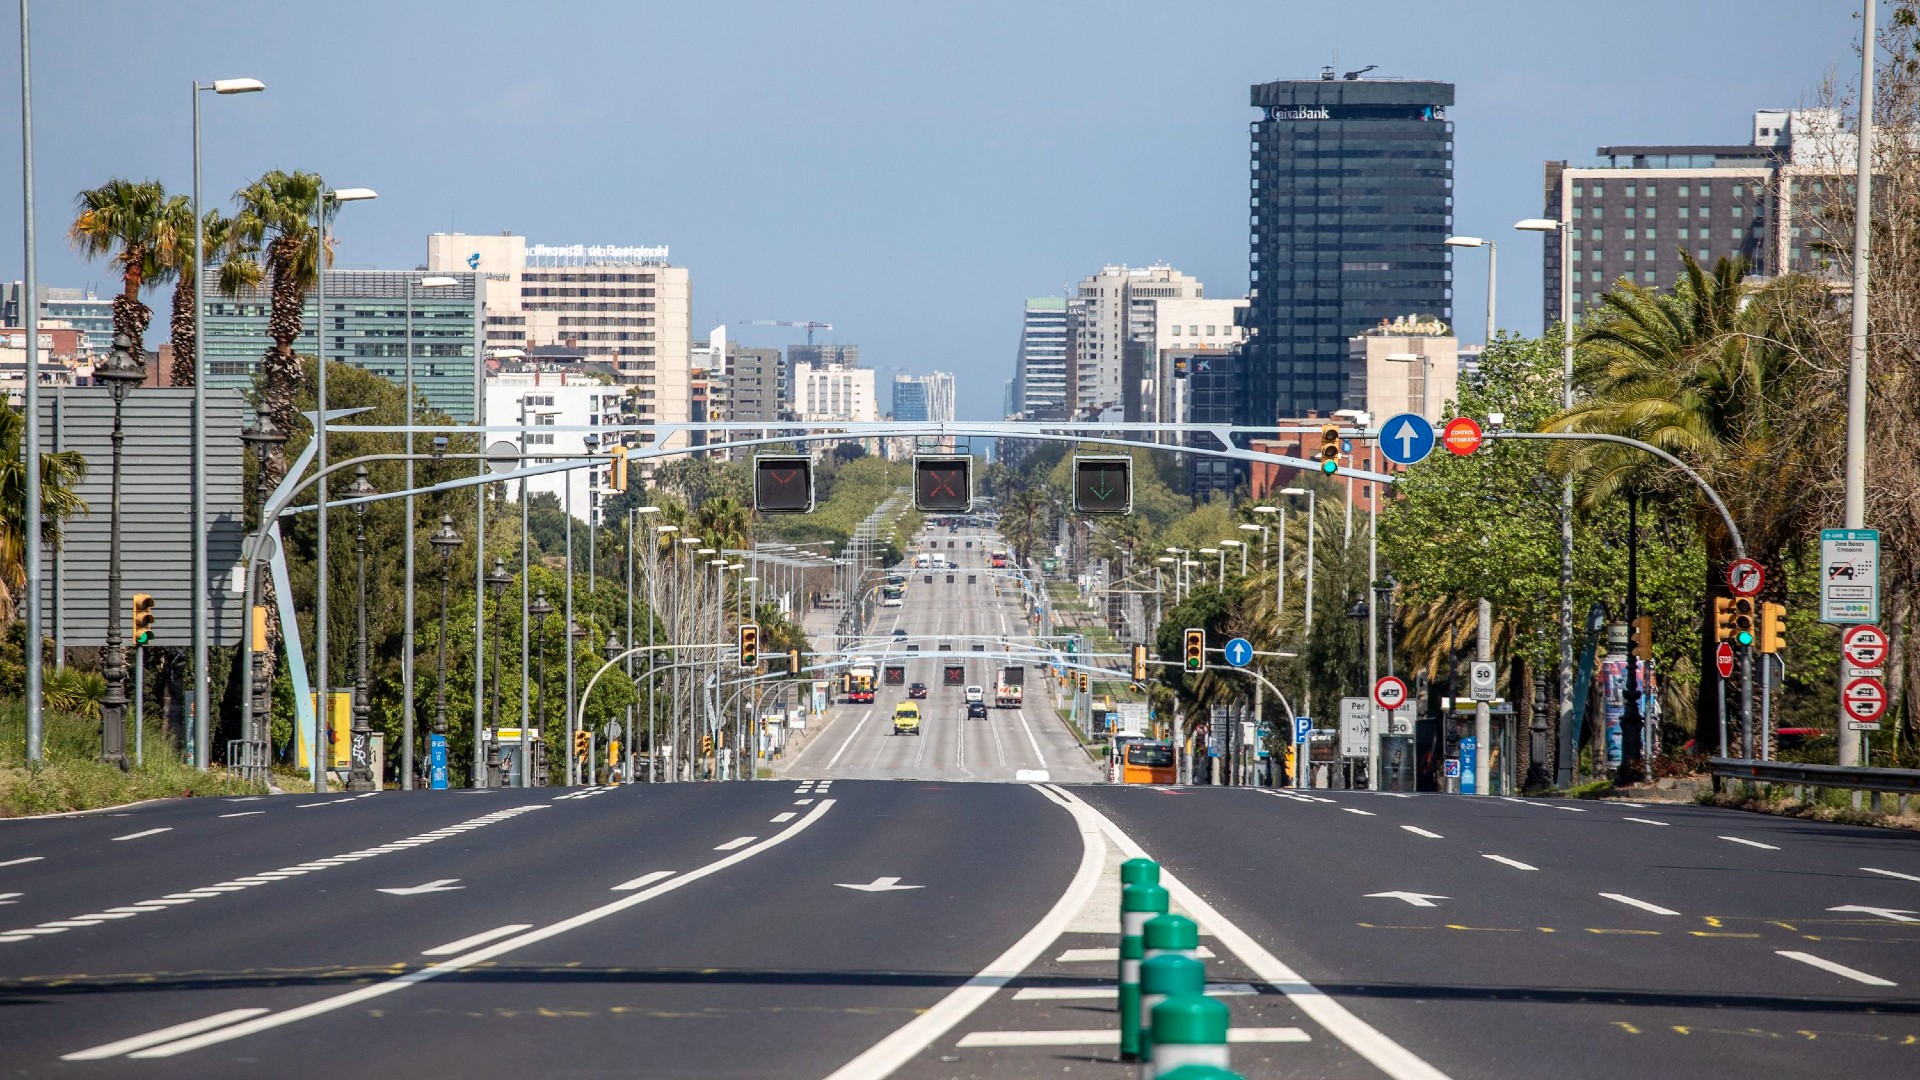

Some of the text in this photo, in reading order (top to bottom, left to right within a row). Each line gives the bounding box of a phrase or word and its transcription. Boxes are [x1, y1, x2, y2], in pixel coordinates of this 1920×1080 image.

[1271, 105, 1330, 120] CaixaBank
[1719, 656, 1732, 664] STOP
[1477, 670, 1490, 678] 50
[1351, 702, 1365, 710] Per
